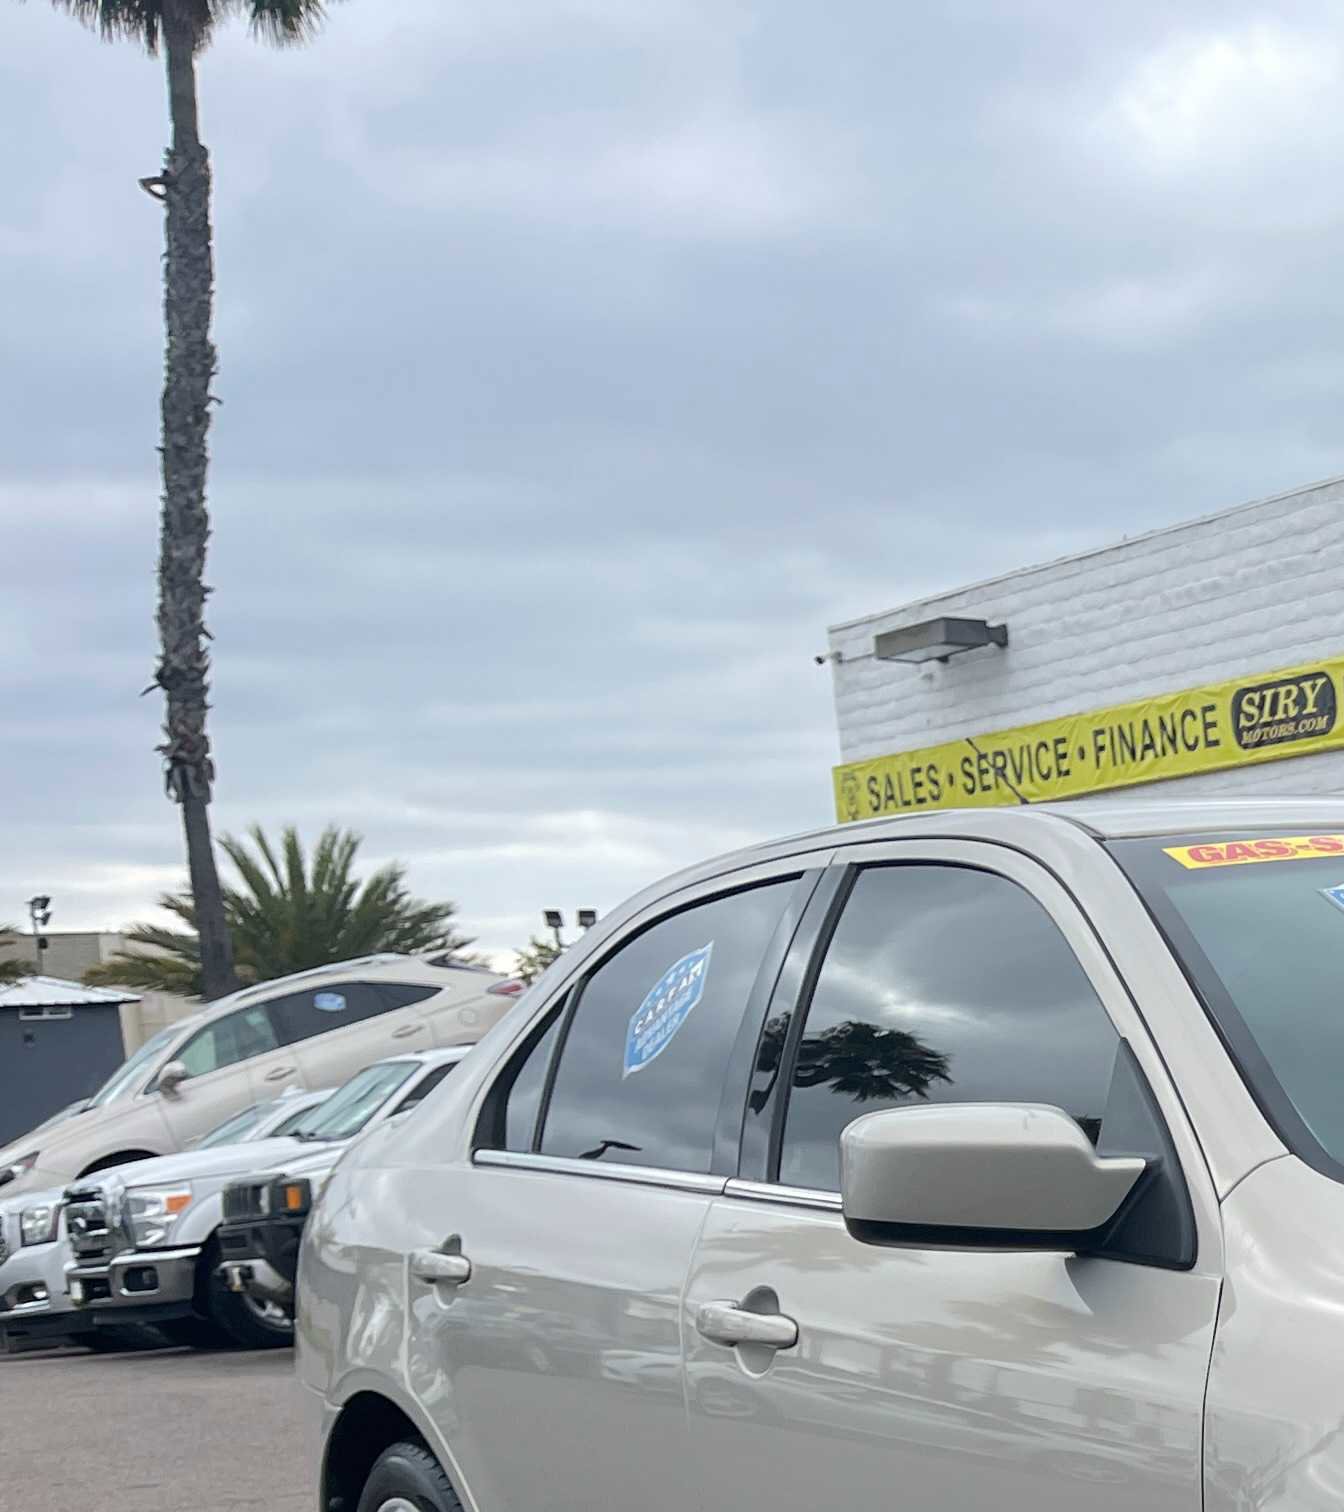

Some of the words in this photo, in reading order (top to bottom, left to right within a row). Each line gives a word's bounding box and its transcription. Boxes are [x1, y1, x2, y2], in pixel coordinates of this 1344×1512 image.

[1239, 677, 1328, 728] SIRY
[1240, 715, 1329, 745] MOTORS.COM
[867, 762, 942, 812] SALES
[961, 736, 1073, 796] SERVICE
[1093, 703, 1221, 769] FINANCE
